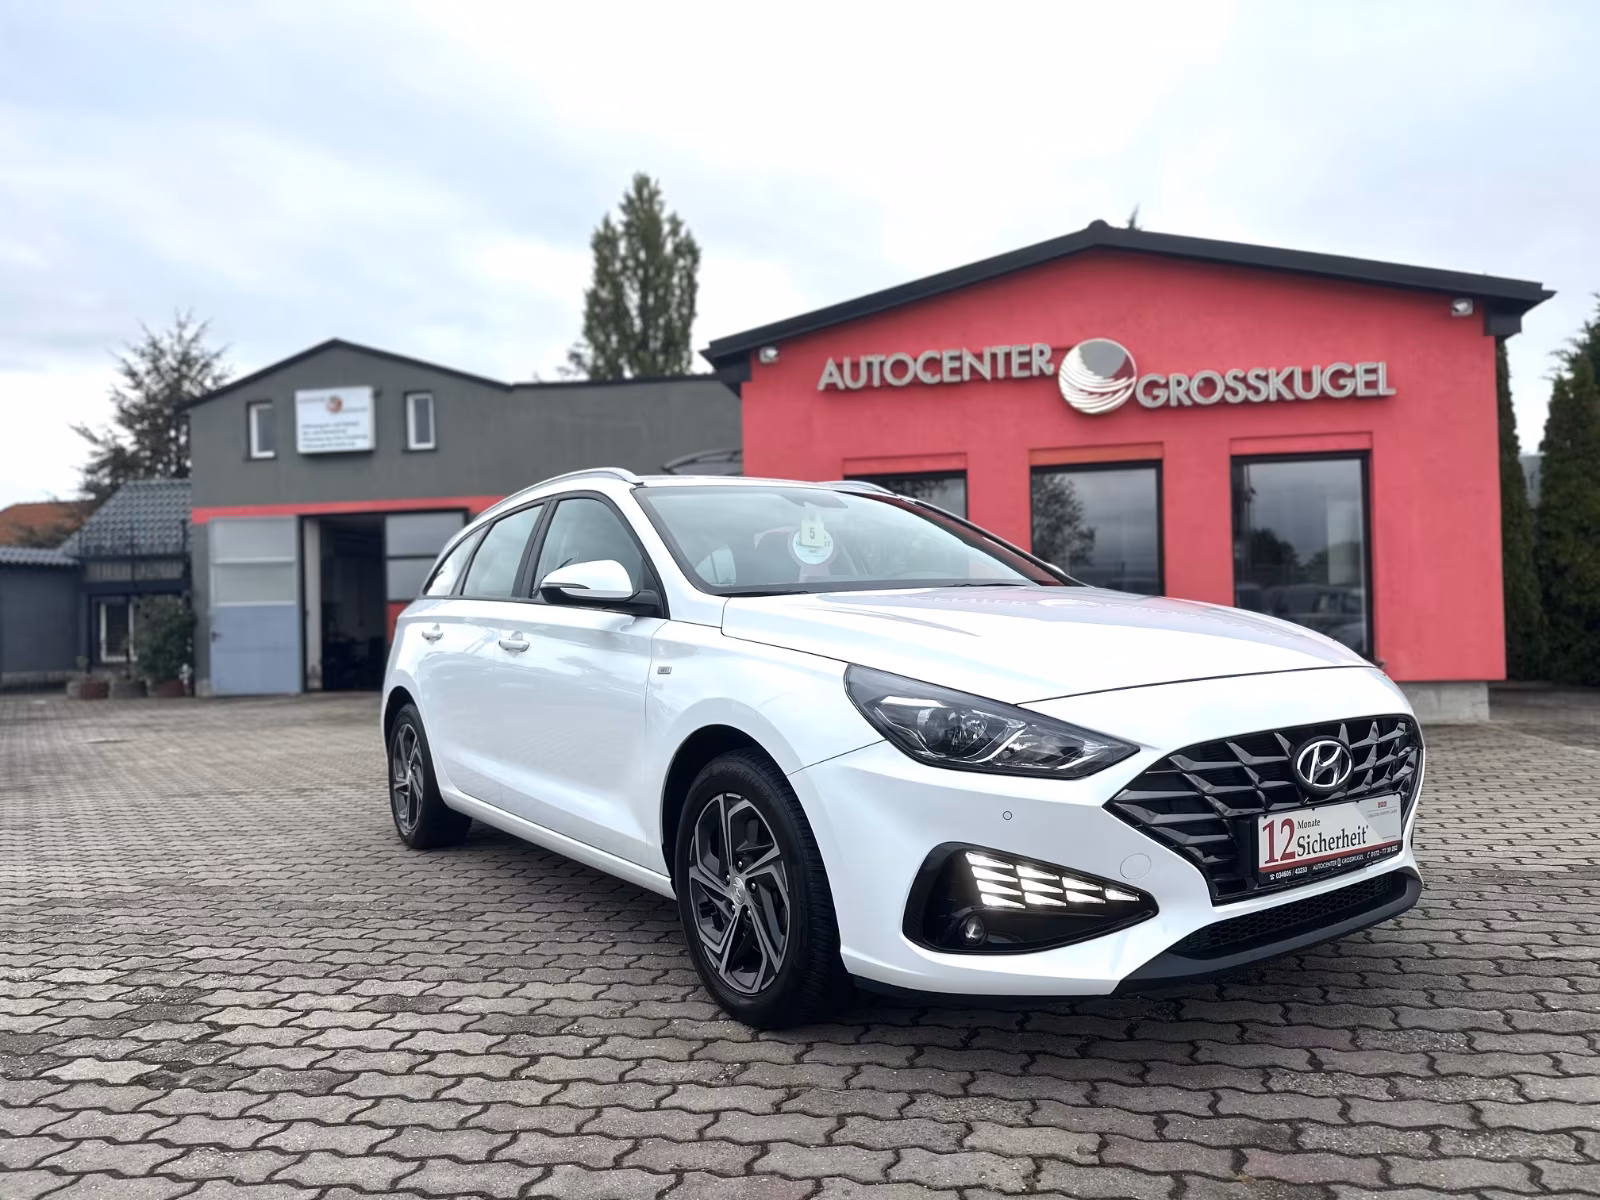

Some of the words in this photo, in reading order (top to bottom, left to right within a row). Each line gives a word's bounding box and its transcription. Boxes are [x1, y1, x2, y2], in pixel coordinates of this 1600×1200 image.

[817, 343, 1055, 391] AUTOCENTER
[1135, 361, 1397, 408] GROSSKUGEL
[809, 526, 816, 540] 5
[1262, 818, 1296, 864] 12
[1297, 819, 1321, 829] Monate
[1312, 859, 1338, 870] AUTOCENTER
